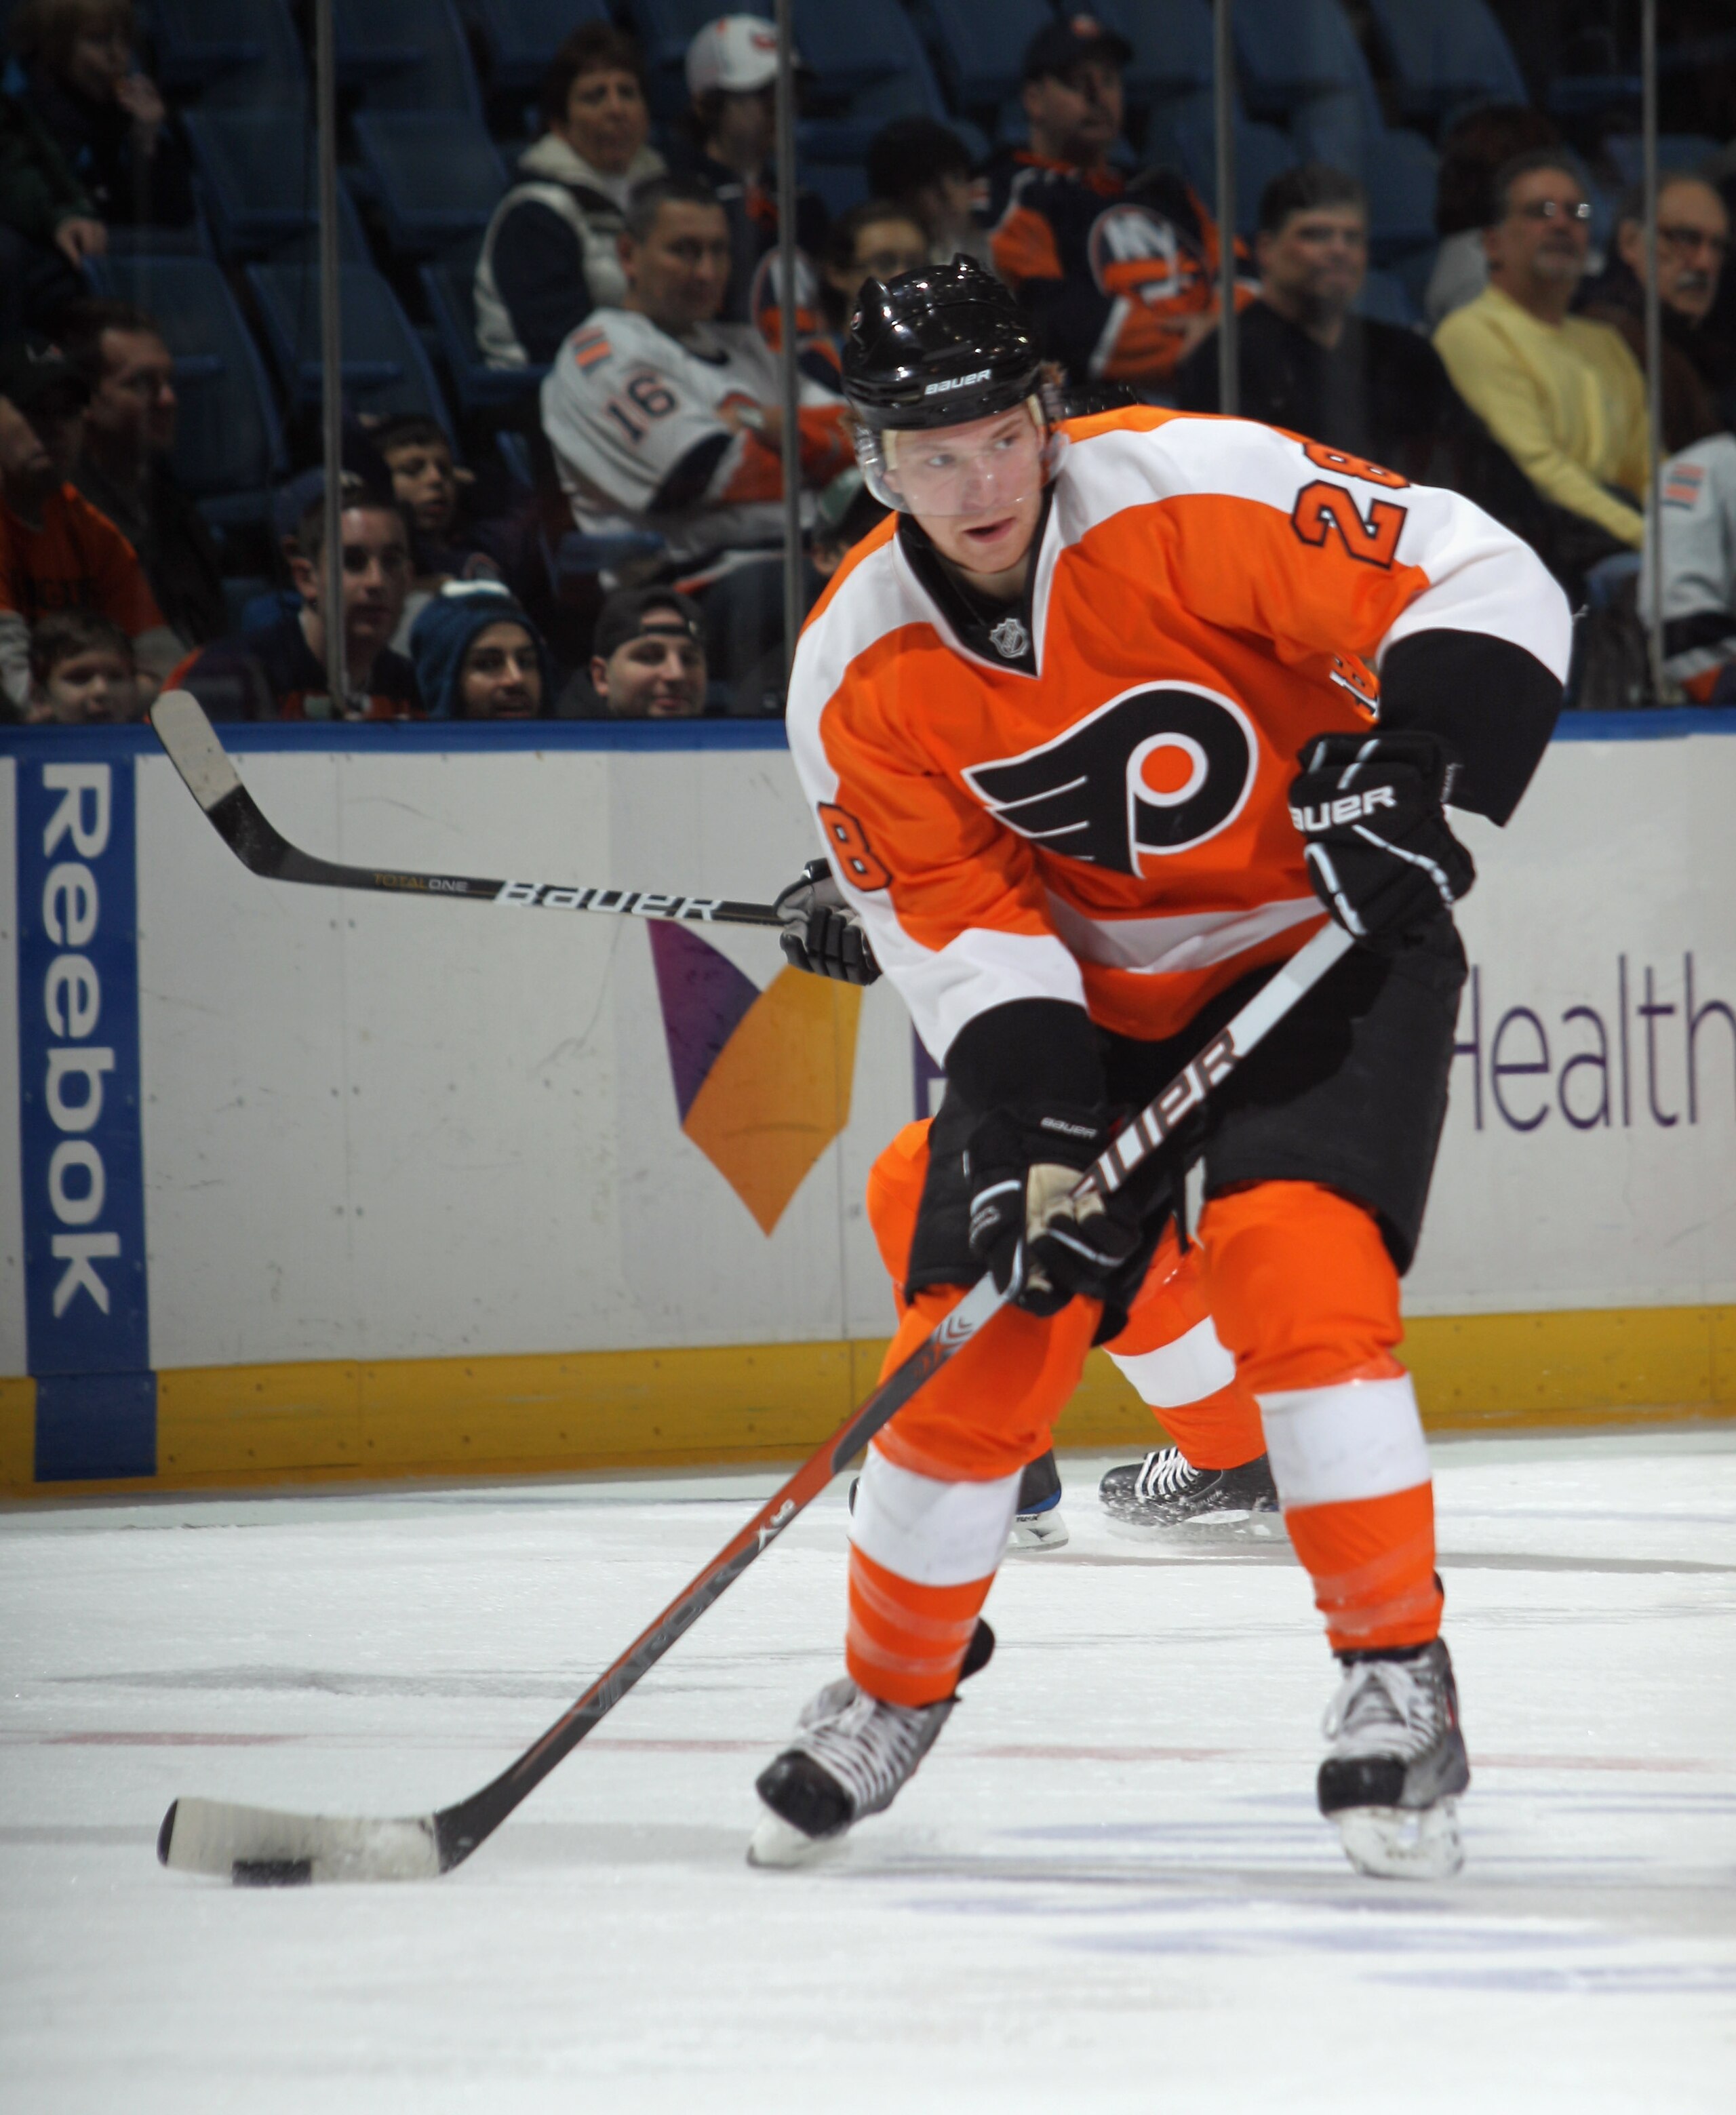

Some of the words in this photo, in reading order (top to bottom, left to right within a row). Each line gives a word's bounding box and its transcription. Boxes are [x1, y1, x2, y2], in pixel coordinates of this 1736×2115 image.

[603, 371, 680, 446] 16
[1290, 441, 1410, 570] 28
[1288, 785, 1397, 832] AUER
[42, 762, 121, 1318] Reebok
